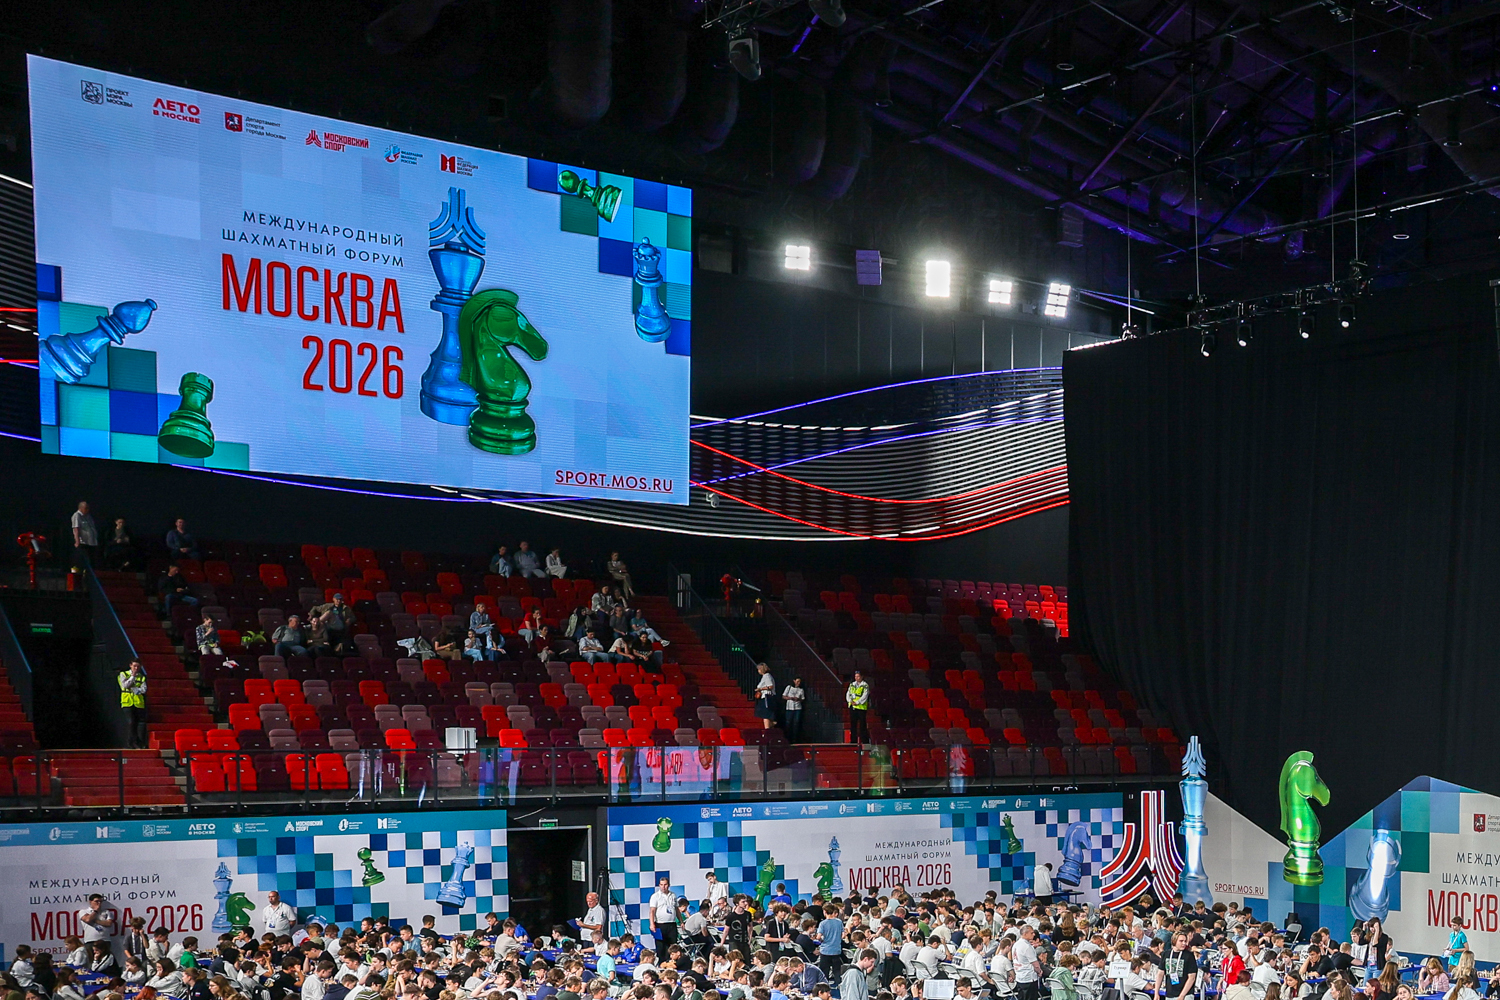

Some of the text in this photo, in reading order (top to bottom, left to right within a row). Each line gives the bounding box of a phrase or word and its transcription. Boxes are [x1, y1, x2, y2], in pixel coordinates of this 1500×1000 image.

[153, 98, 200, 116] ЛЕТО
[162, 111, 201, 124] МОСКВЕ
[323, 132, 369, 149] МОСКОВСКИЙ
[323, 140, 346, 152] СПОРТ
[242, 211, 405, 247] МЕЖДУНАРОДНЫЙ
[222, 228, 404, 267] ШАХМАТНЫЙ ФОРУМ
[222, 253, 405, 334] МОСКВА
[302, 335, 404, 400] 2026
[555, 469, 673, 492] SPORT.MOS.RU
[188, 823, 216, 831] ЛЕТО
[874, 838, 951, 850] МЕЖДУНАРОДНЫЙ
[865, 851, 952, 862] ШАХМАТНЫЙ ФОРУМ
[29, 873, 160, 889] МЕЖДУНАРОДНЫЙ
[849, 863, 951, 891] МОСКВА 2026
[29, 890, 177, 905] ШАХМАТЫЙ ФОРУМ
[1214, 883, 1264, 895] SPORT.MOS.RU
[146, 903, 203, 935] 2026
